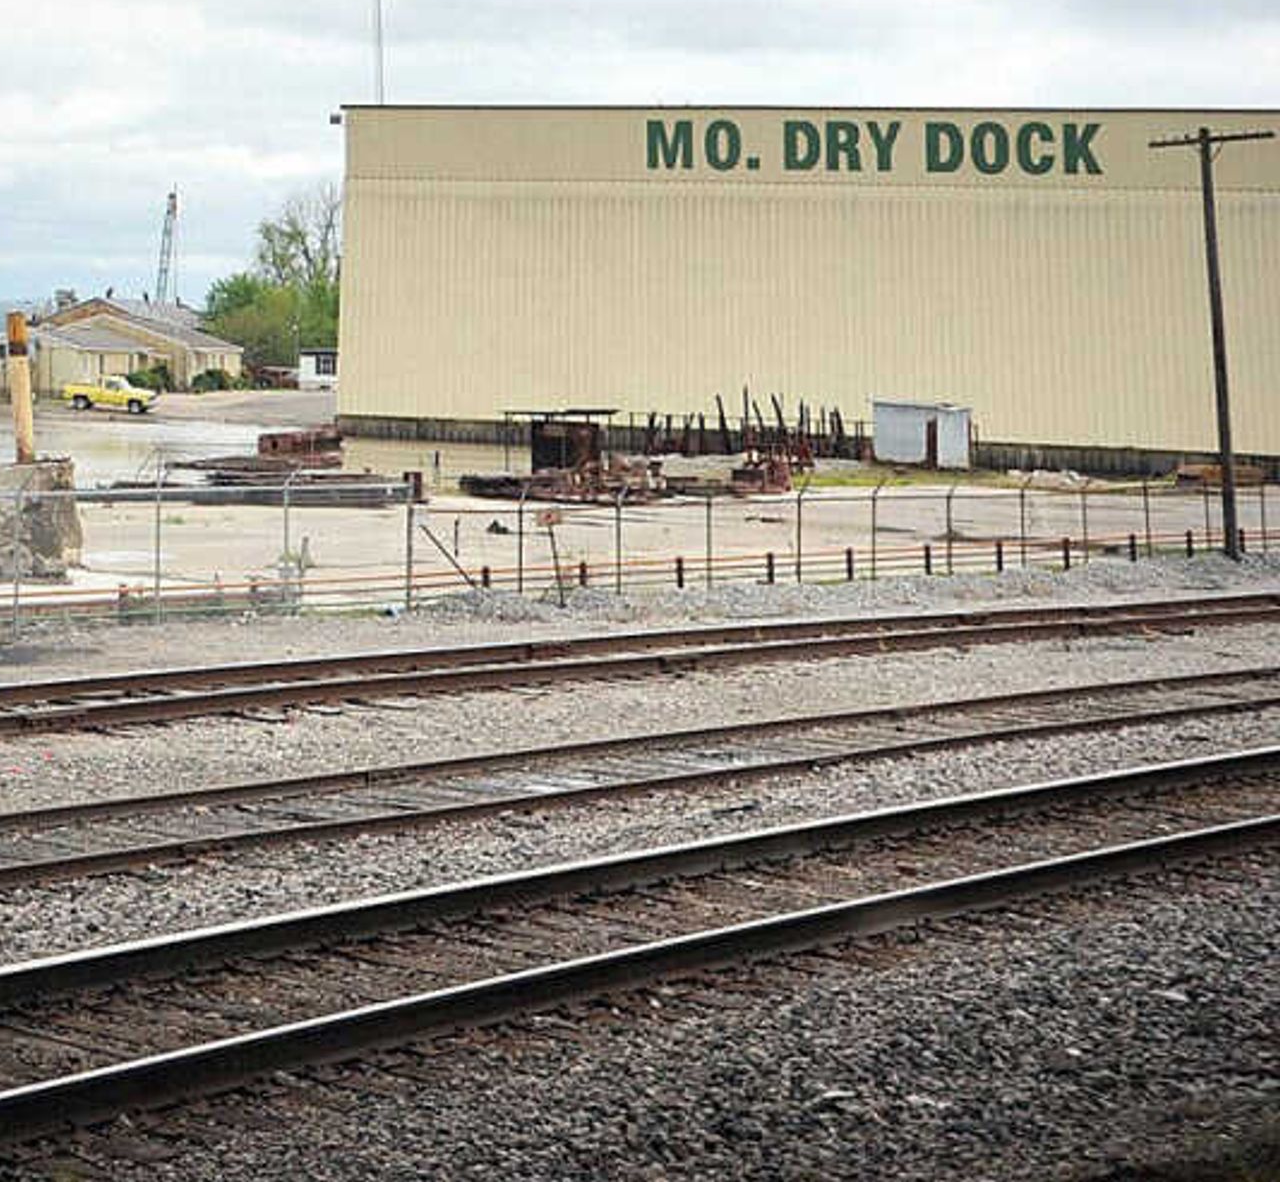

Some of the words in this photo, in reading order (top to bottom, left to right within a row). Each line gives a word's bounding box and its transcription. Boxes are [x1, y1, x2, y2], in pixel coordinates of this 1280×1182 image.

[646, 119, 761, 171] MO.
[783, 120, 901, 172] DRY
[925, 122, 1103, 175] DOCK
